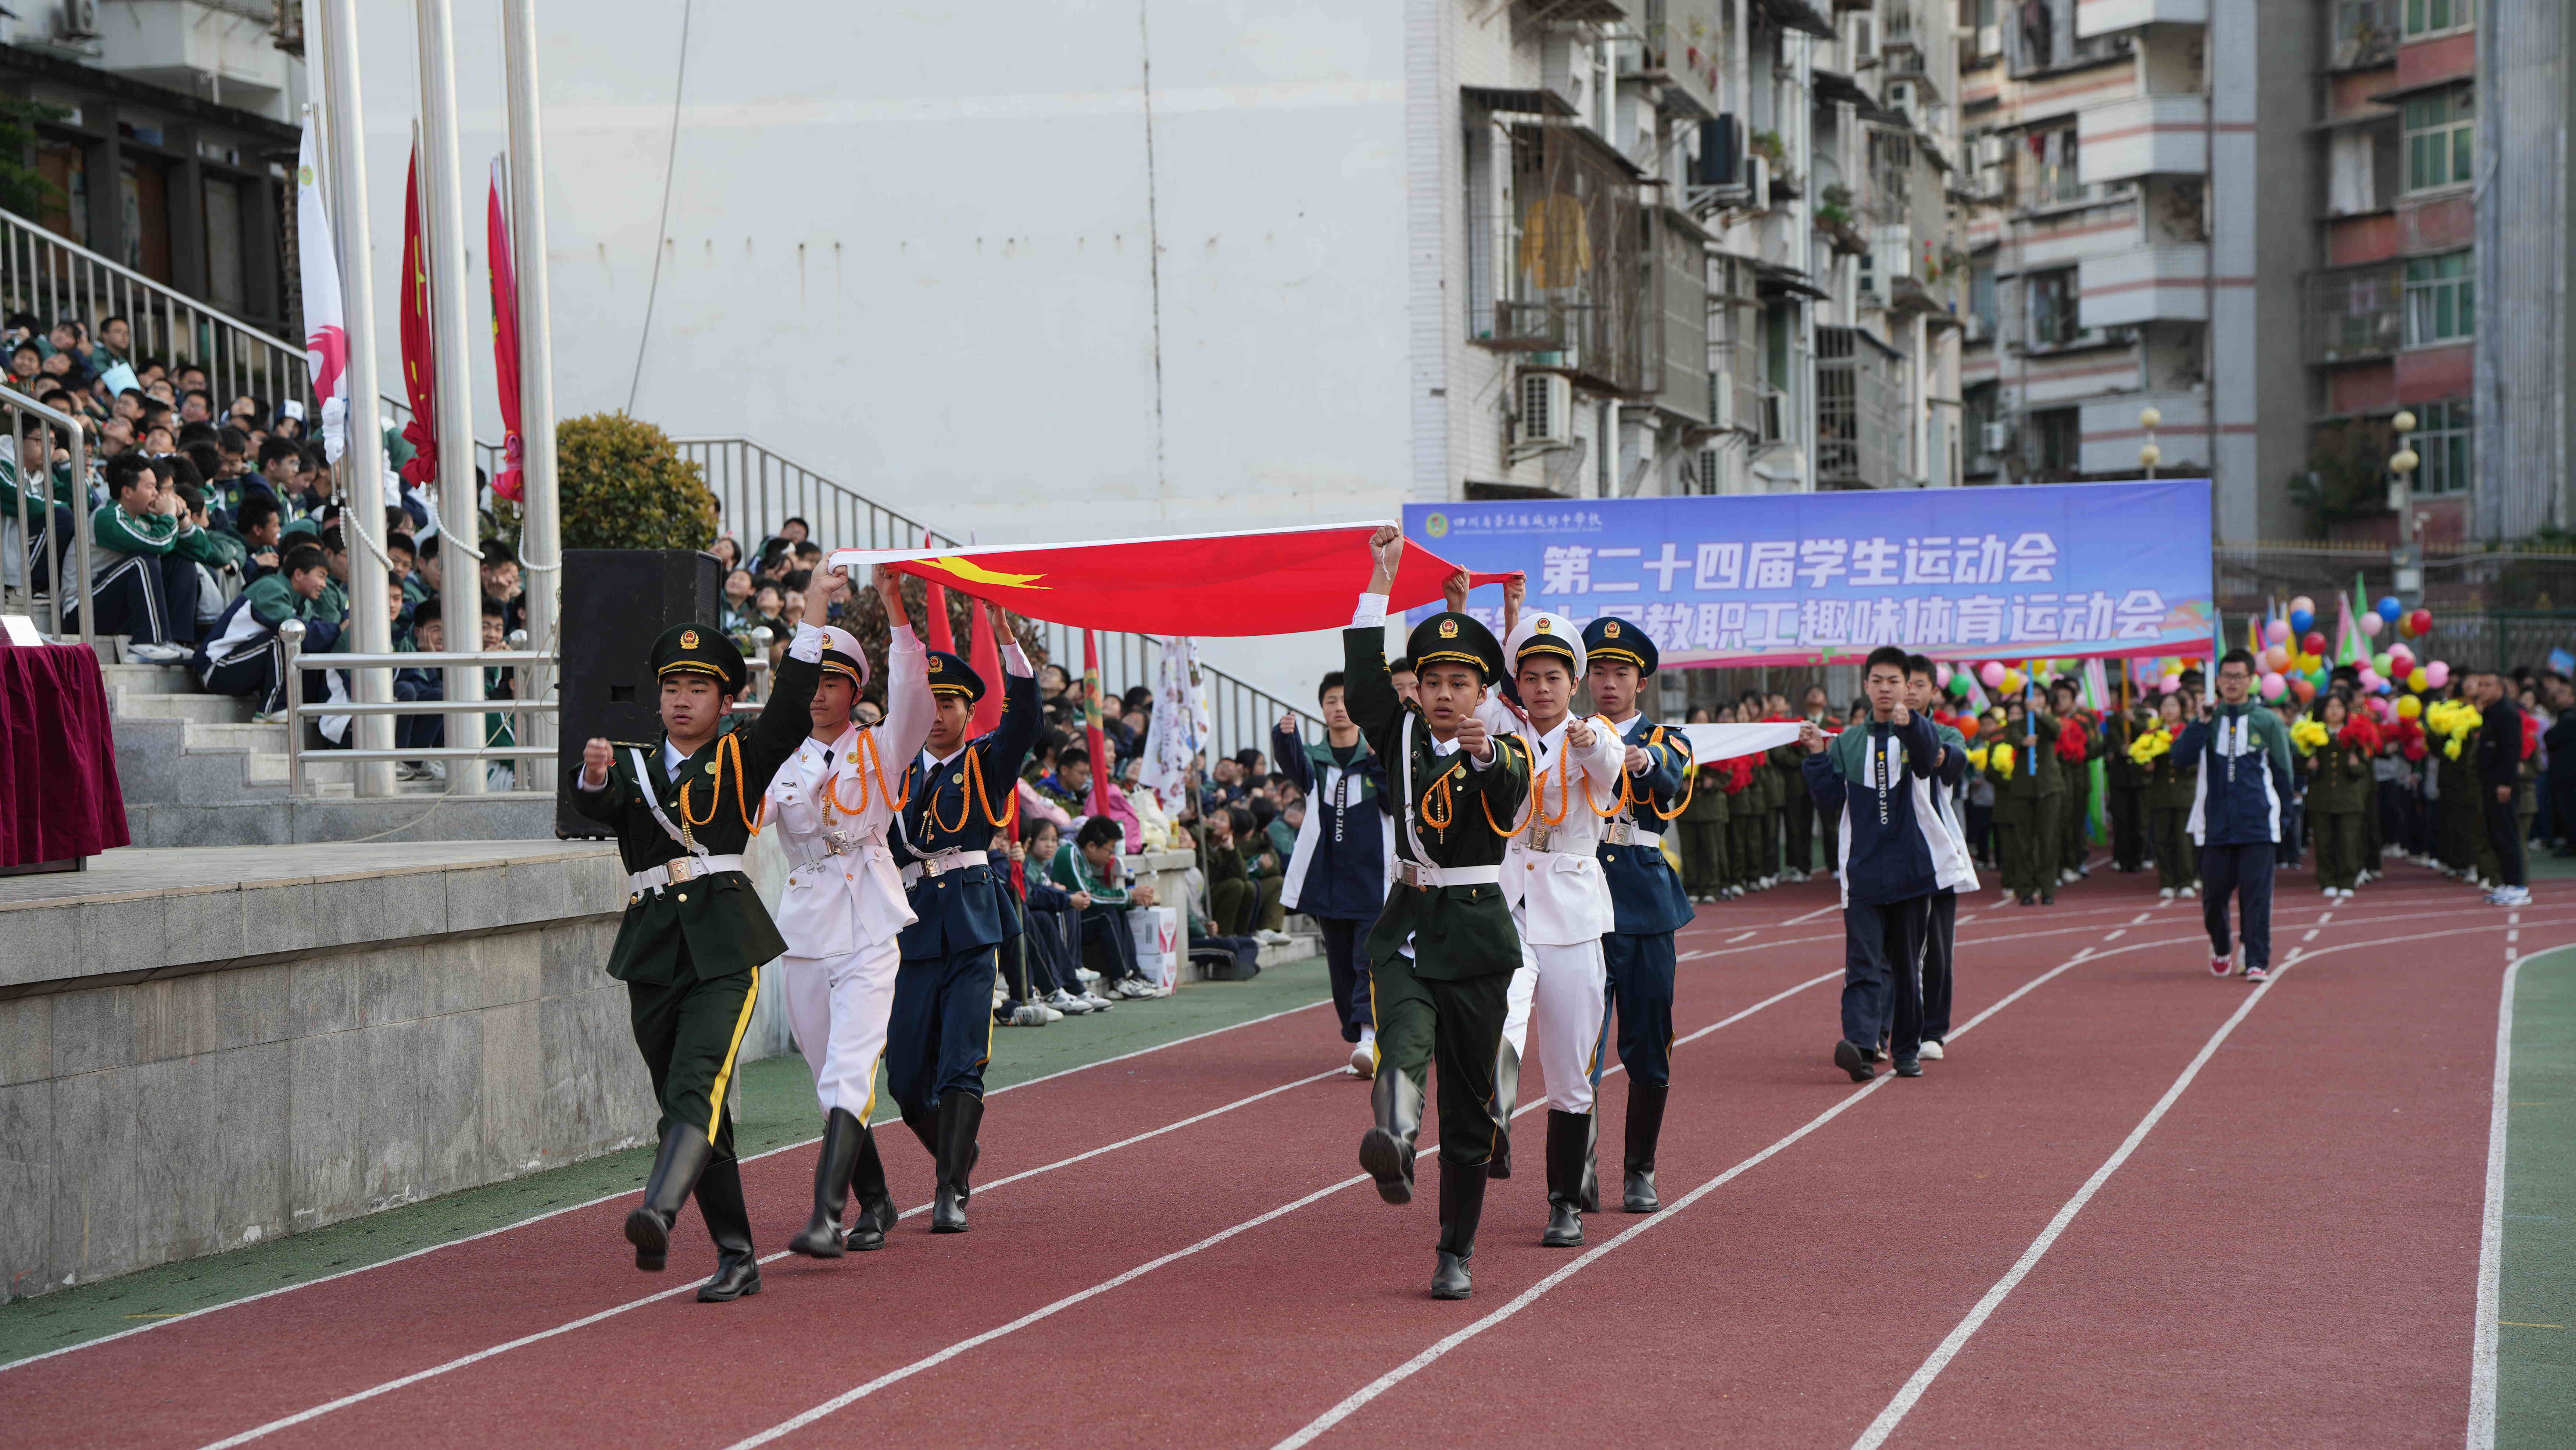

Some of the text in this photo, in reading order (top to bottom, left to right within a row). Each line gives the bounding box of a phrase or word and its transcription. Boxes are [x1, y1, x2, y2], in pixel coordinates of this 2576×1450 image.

[1540, 532, 2058, 594] 第二十四届学生运动会
[1335, 779, 1346, 842] CHENG JIAO
[1877, 761, 1888, 825] CHENG JIAO
